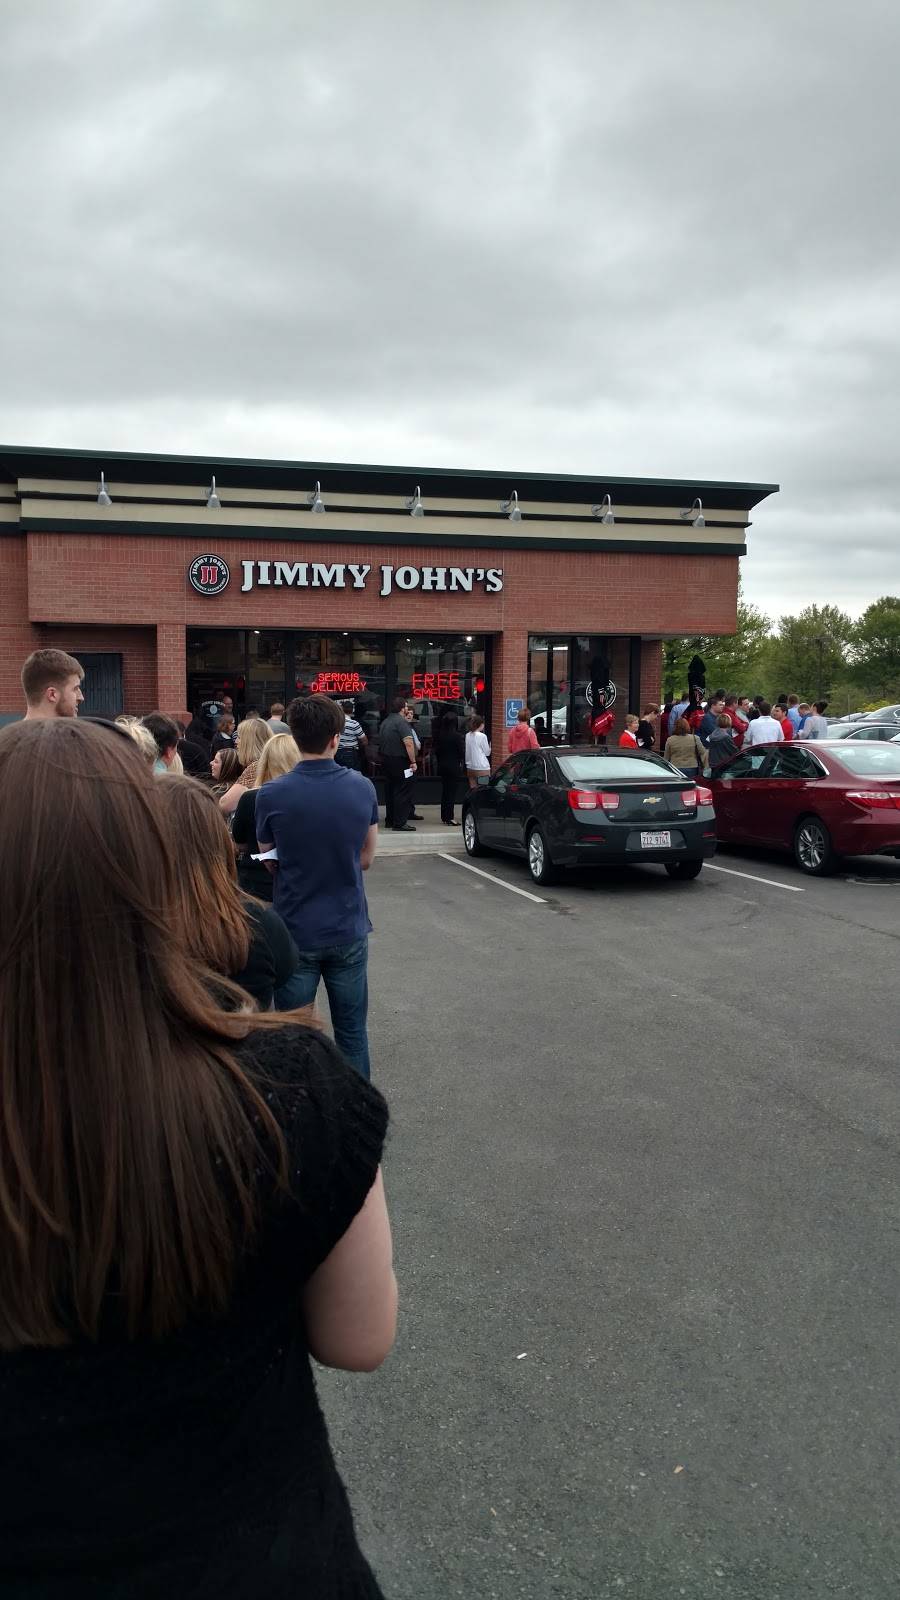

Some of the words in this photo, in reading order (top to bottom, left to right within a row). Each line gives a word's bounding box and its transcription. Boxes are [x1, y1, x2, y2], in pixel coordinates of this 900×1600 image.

[200, 565, 218, 585] JJ
[241, 560, 371, 592] JIMMY
[380, 565, 503, 596] JOHN'S
[318, 672, 360, 683] SERIOUS
[412, 673, 460, 689] FREE
[311, 681, 367, 693] DELIVERY
[413, 687, 461, 700] SMELLS
